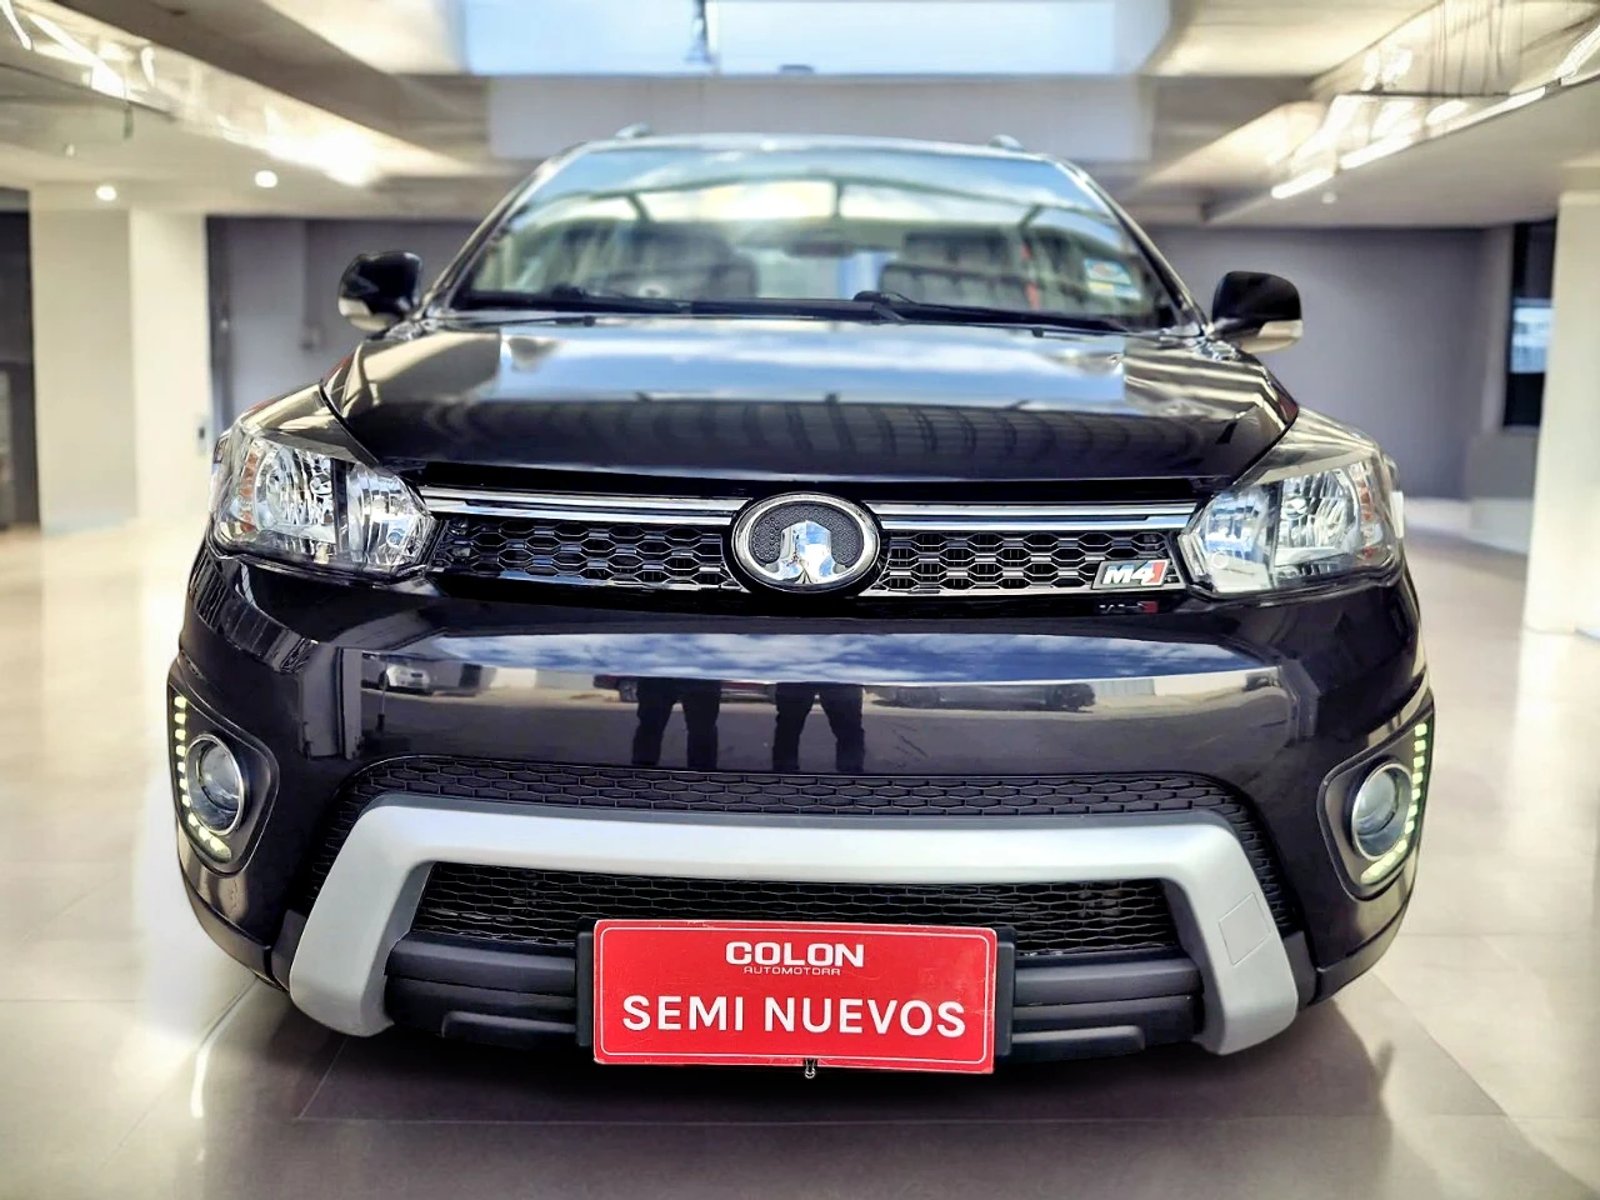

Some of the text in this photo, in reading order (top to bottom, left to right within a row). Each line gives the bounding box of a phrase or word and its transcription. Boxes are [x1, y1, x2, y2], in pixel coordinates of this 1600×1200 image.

[1103, 560, 1168, 586] M4
[726, 941, 864, 967] COLON
[743, 966, 840, 976] AUTOMOTORA
[622, 995, 966, 1037] SEMI NUEVOS
